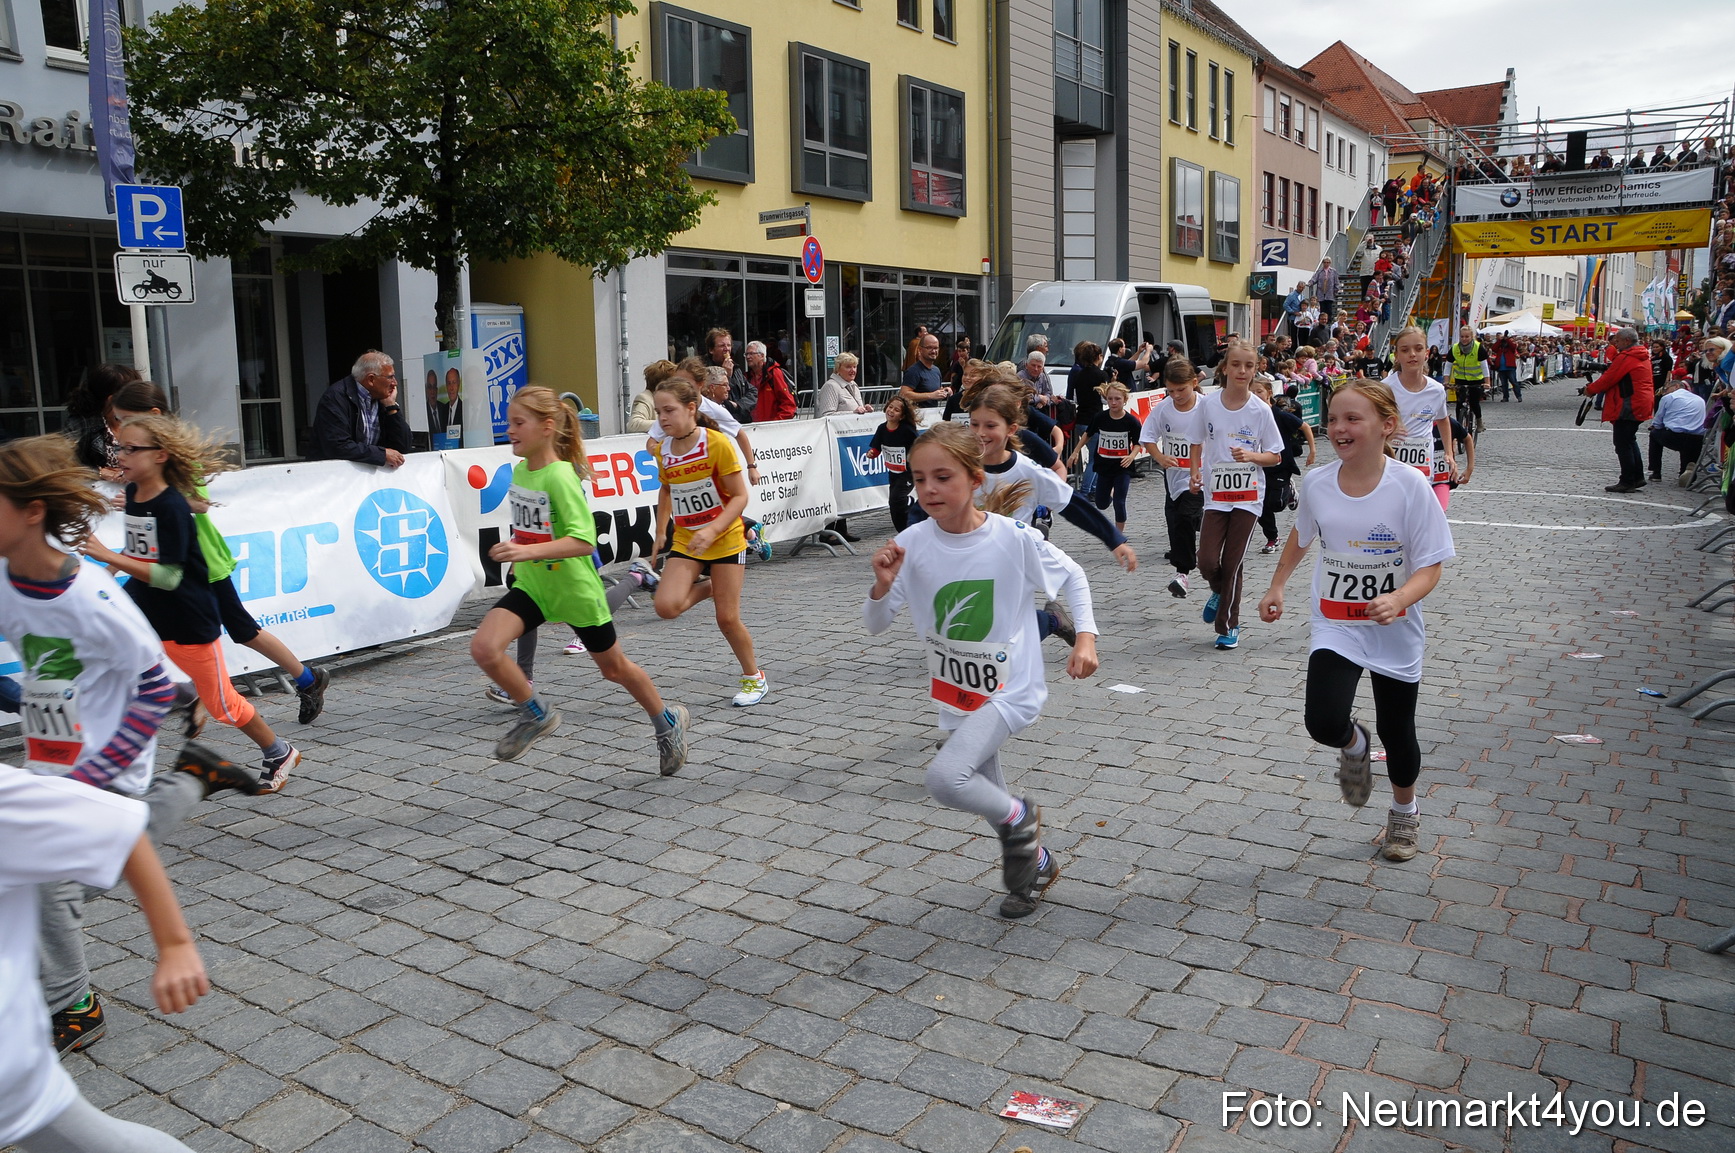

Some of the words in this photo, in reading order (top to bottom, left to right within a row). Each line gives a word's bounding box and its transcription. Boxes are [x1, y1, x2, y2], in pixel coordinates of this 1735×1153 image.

[1526, 187, 1556, 198] BMW
[1558, 181, 1661, 196] EfficientDynamics
[1556, 194, 1595, 204] Verbrauch.
[132, 193, 167, 240] P
[760, 210, 804, 222] Brunnwirtsgasse
[1529, 222, 1618, 245] START
[143, 259, 166, 268] nur
[1101, 438, 1125, 449] 7198
[753, 444, 813, 462] Kastengasse
[1392, 447, 1425, 464] 7006
[772, 470, 803, 483] Herzen
[1215, 473, 1251, 490] 7007
[760, 489, 775, 502] der
[778, 484, 799, 499] Stadt
[674, 491, 714, 514] 7160
[785, 502, 832, 521] Neumarkt
[1322, 556, 1346, 568] PARTL
[1347, 560, 1390, 570] Neumarkt
[1327, 571, 1397, 601] 7284
[949, 647, 992, 661] Neumarkt
[934, 649, 998, 693] 7008
[956, 691, 975, 708] Mia
